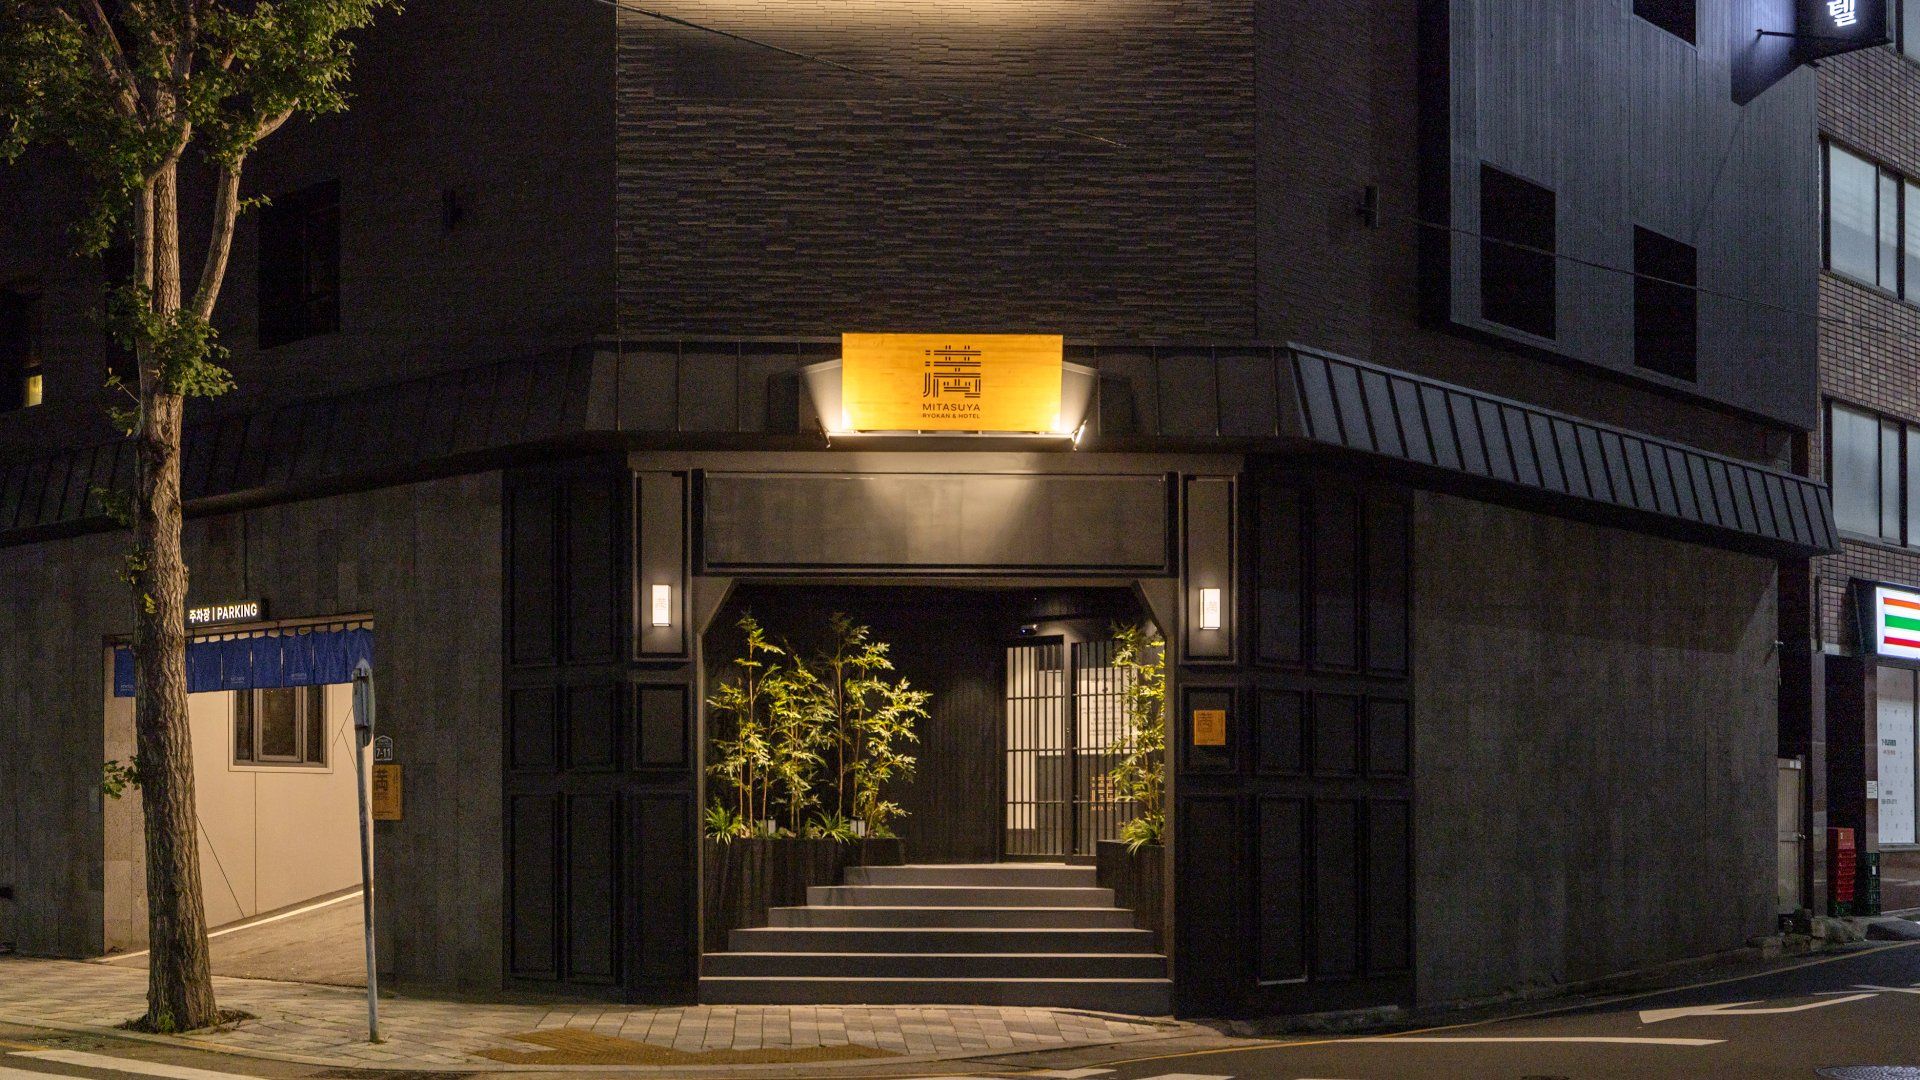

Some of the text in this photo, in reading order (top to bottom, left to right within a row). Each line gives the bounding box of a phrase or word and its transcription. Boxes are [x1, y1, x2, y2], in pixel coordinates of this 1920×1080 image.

[1827, 0, 1857, 27] 텔
[922, 403, 980, 411] MITASUYA
[189, 603, 257, 623] 주차장 PARKING
[376, 747, 392, 757] 7-11
